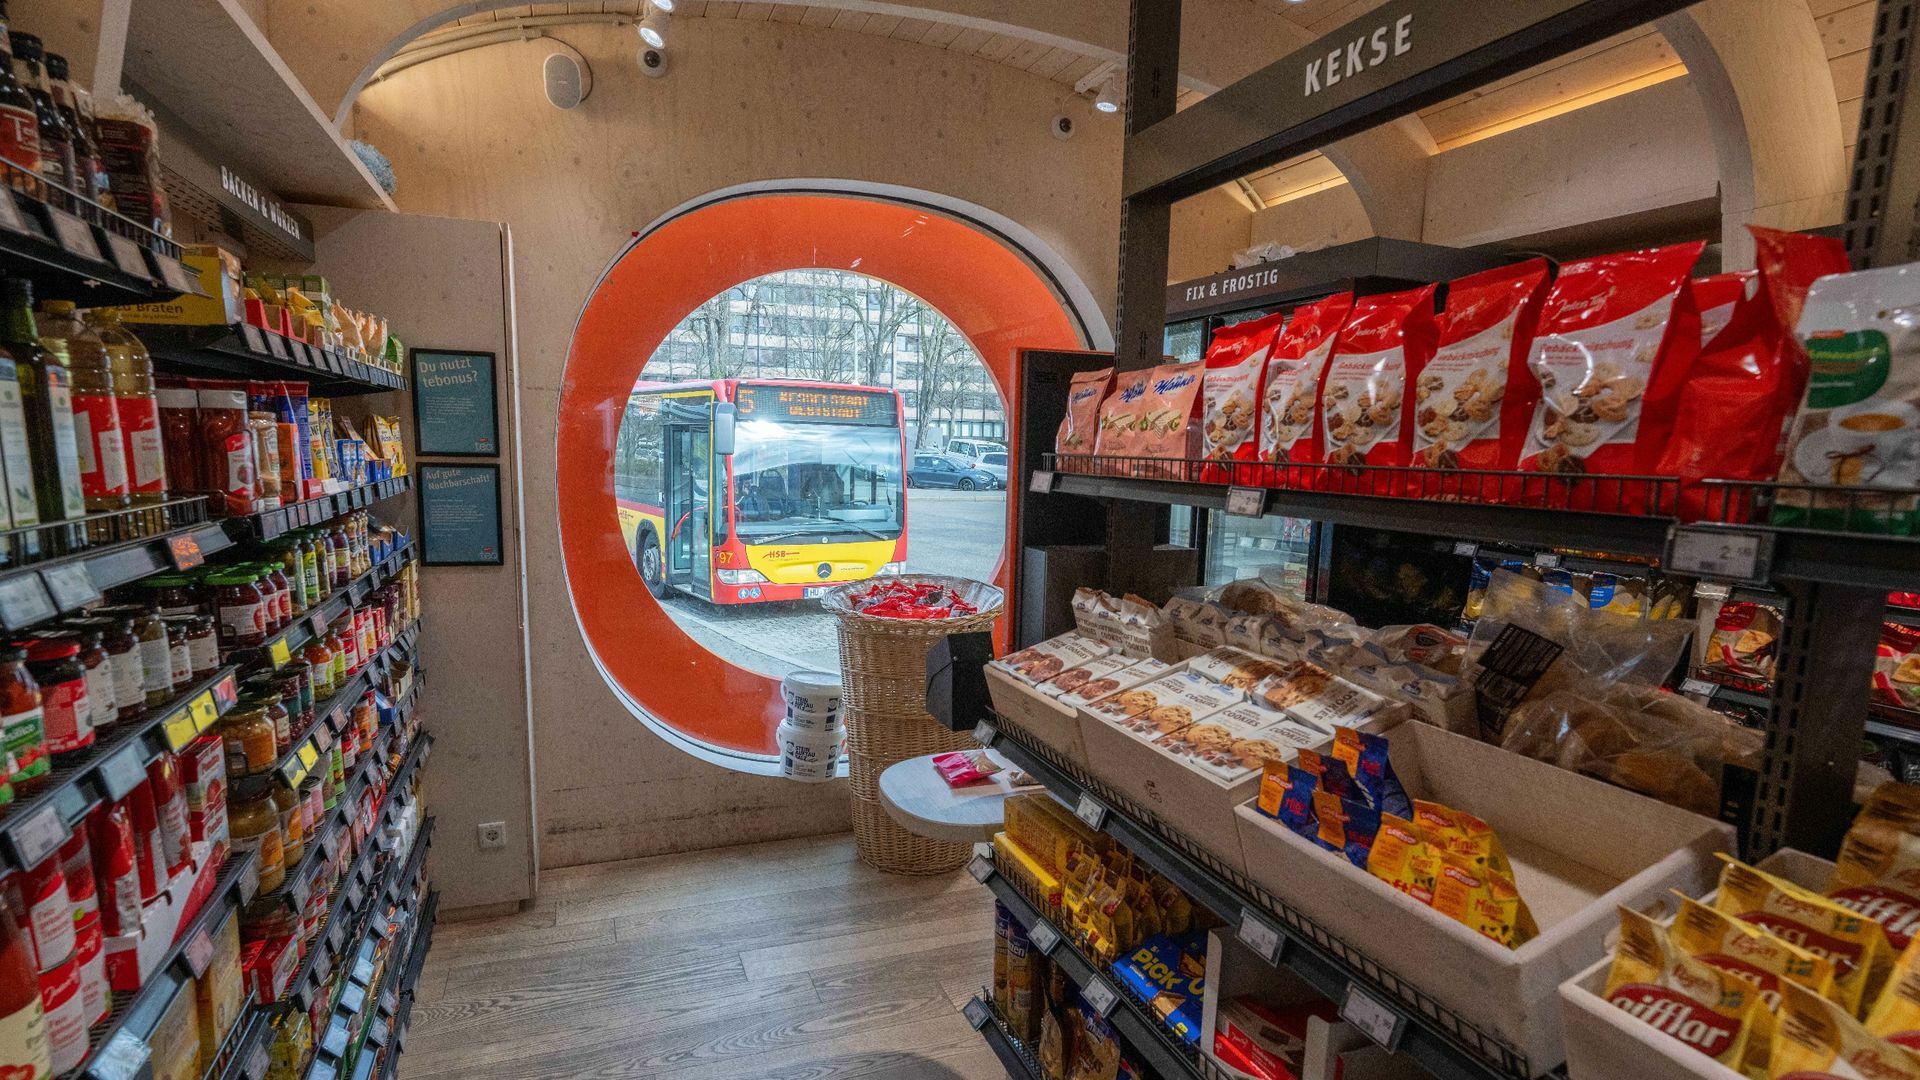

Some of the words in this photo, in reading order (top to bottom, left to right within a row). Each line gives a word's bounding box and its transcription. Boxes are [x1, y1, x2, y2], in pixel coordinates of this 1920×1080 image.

[1304, 13, 1413, 97] KEKSE
[221, 165, 259, 211] BACKEN
[261, 196, 268, 218] &
[269, 201, 300, 240] WÜRZEN
[1186, 285, 1206, 301] FIX
[1209, 282, 1218, 297] &
[1222, 268, 1279, 294] FROSTIG
[136, 302, 183, 314] Braten
[419, 361, 437, 374] Du
[440, 357, 472, 371] nutzt
[422, 370, 478, 388] tebonus?
[1153, 374, 1195, 395] Manner
[738, 389, 754, 413] 5
[426, 471, 441, 480] Auf
[442, 469, 461, 480] gute
[428, 474, 490, 491] Nachbarschaft!
[719, 551, 734, 565] 97
[769, 550, 786, 559] HSB
[810, 588, 820, 597] HU
[1153, 679, 1184, 695] COOKIES
[1185, 693, 1220, 708] COOKIES
[1314, 690, 1359, 721] COOKIES
[1222, 710, 1261, 727] COOKIES
[1269, 727, 1311, 746] COOKIES
[1450, 837, 1480, 850] Minis
[1474, 898, 1505, 916] Minis
[1188, 977, 1205, 995] U
